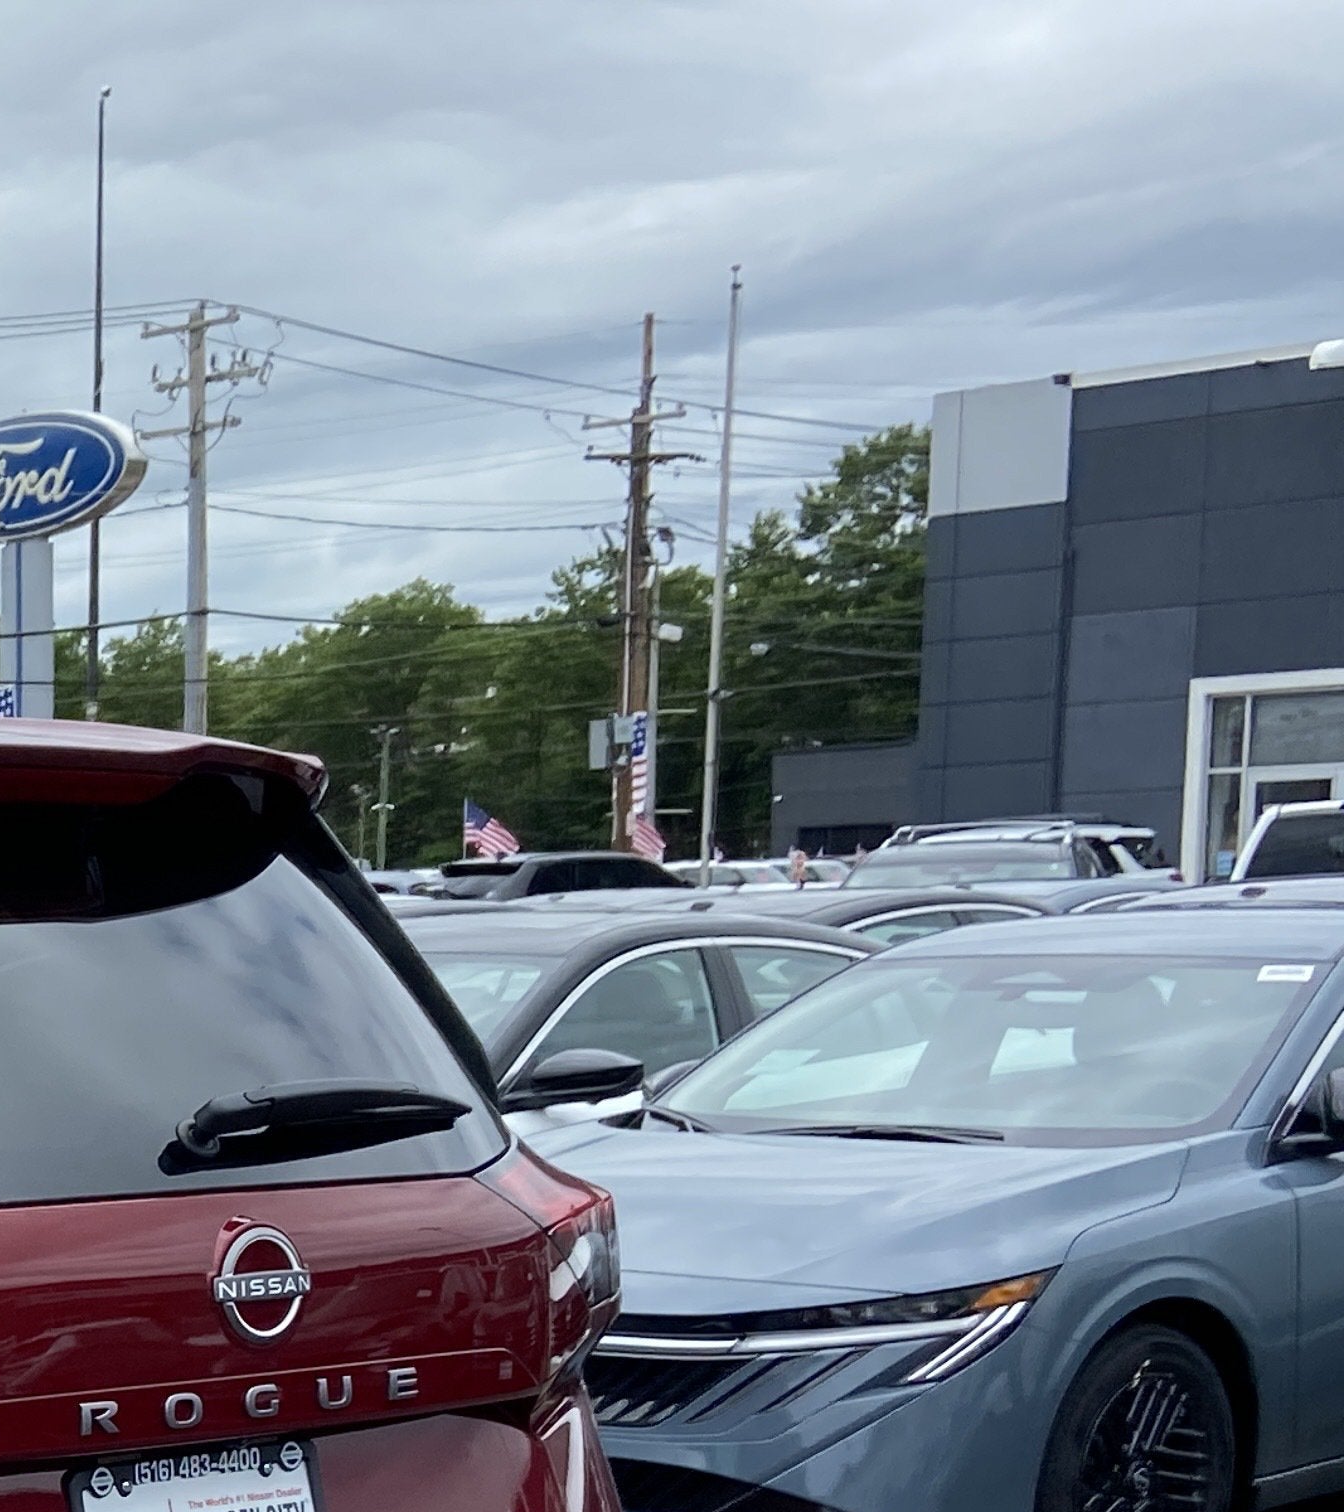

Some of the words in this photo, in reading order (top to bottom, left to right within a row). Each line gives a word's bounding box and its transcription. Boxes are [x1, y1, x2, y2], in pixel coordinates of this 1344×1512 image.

[218, 1275, 310, 1298] NISSAN
[79, 1366, 419, 1436] ROGUE
[134, 1458, 175, 1483] (516)
[179, 1447, 261, 1480] 483-4400
